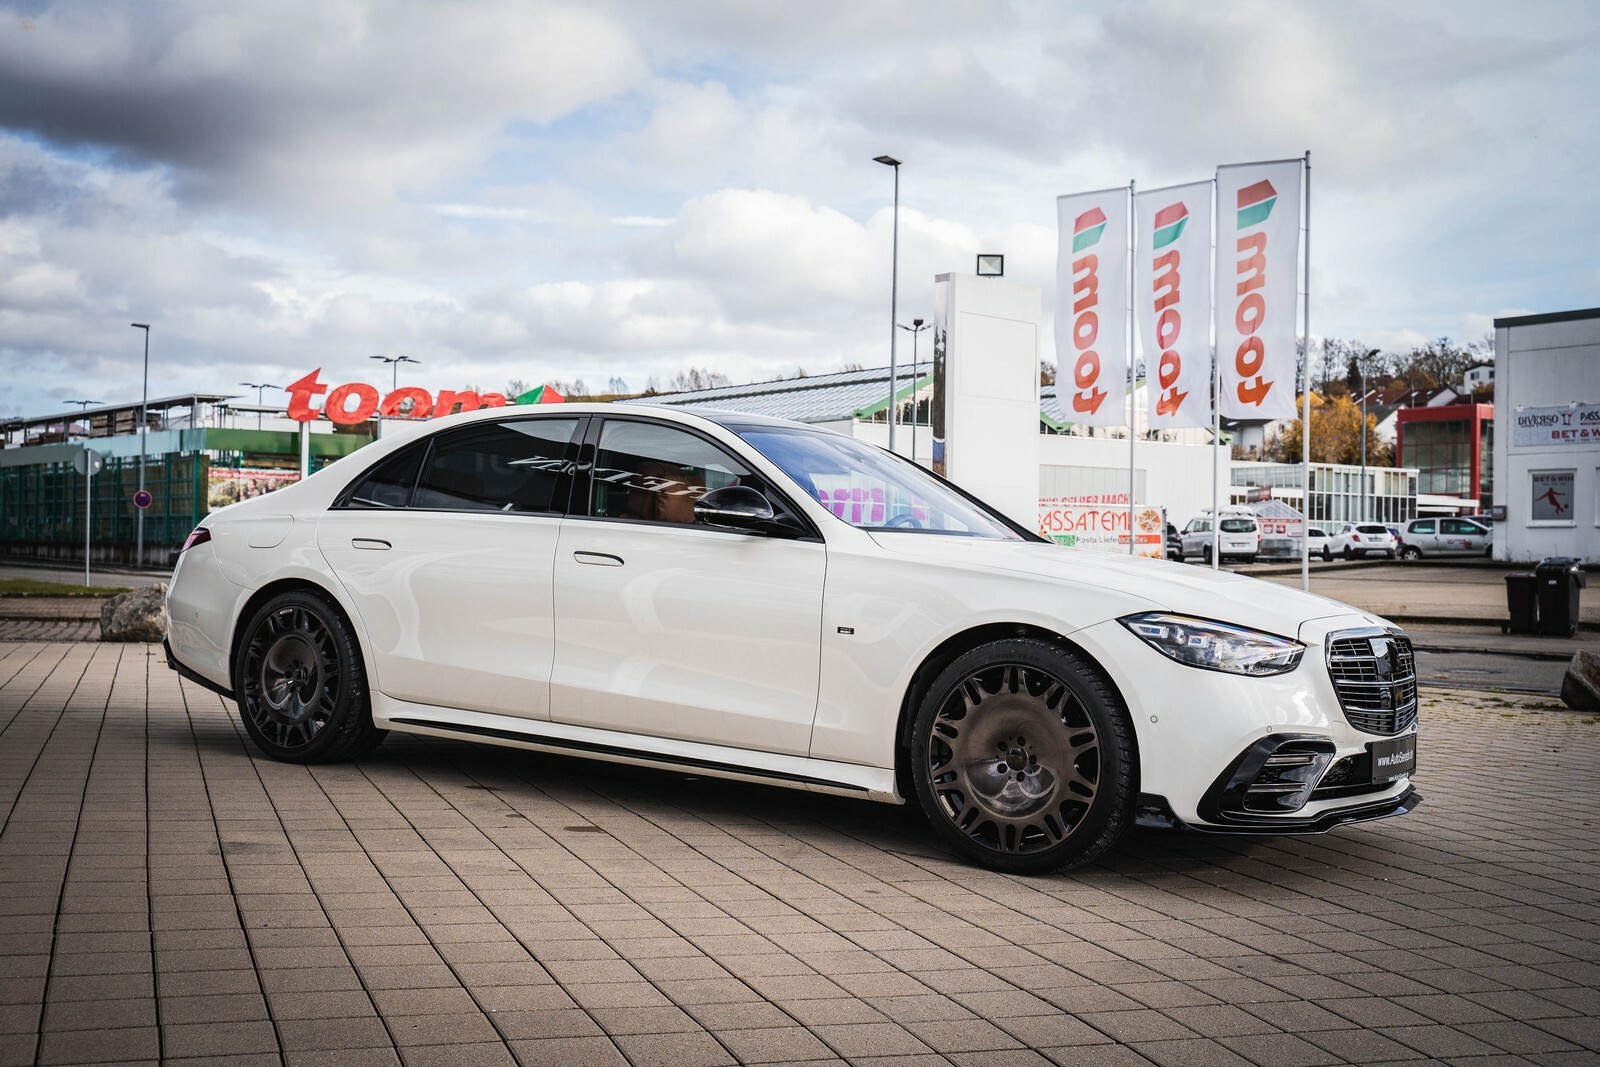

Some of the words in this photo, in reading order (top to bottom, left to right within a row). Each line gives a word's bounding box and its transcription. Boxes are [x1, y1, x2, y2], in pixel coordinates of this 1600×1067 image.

[285, 367, 506, 425] toom
[1518, 415, 1559, 426] DIVERSO
[1552, 429, 1578, 439] BET
[1580, 428, 1589, 438] &
